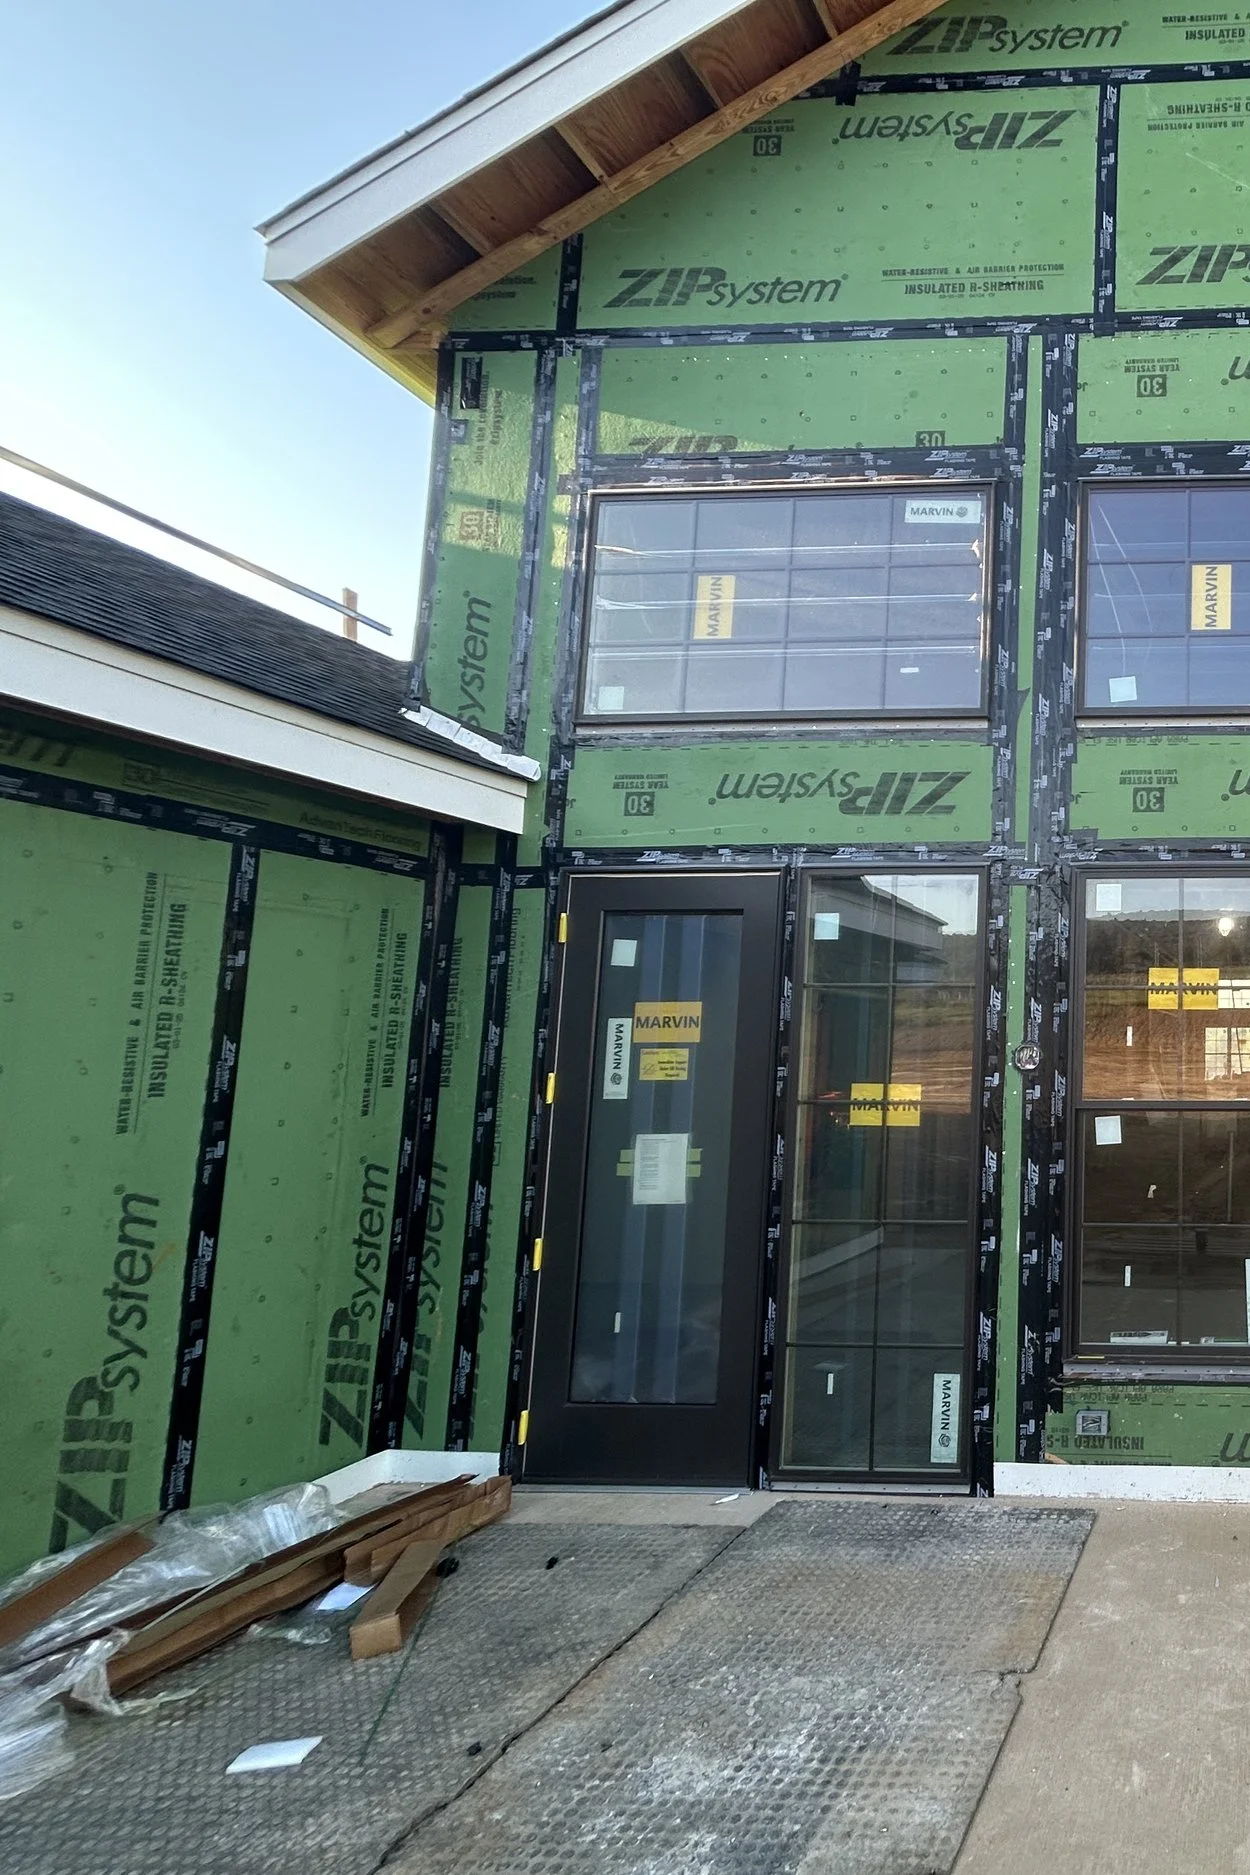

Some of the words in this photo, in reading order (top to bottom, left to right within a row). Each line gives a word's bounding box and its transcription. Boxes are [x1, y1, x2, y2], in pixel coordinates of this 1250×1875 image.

[1185, 28, 1246, 41] INSULATED
[1167, 101, 1242, 115] R-SHEATHING
[755, 136, 780, 156] 30
[882, 266, 949, 277] WATER-RESISTIVE
[966, 265, 981, 274] AIR
[1019, 262, 1065, 272] PROTECTION
[905, 282, 966, 295] INSULATED
[1124, 365, 1154, 374] SYSTEM
[1155, 364, 1181, 373] YEAR
[1139, 375, 1166, 397] 30
[917, 432, 944, 447] 30
[909, 506, 954, 518] MARVIN
[705, 576, 722, 637] MARVIN
[1205, 565, 1218, 629] MARVIN
[612, 781, 642, 790] SYSTEM
[643, 780, 669, 789] YEAR
[1119, 776, 1151, 786] SYSTEM
[1153, 775, 1179, 785] YEAR
[625, 793, 654, 815] 30
[1135, 788, 1163, 811] 30
[141, 871, 158, 936] PROTECTION
[134, 939, 151, 986] BARRIER
[159, 902, 188, 1007] R-SHEATHING
[131, 989, 145, 1010] AIR
[382, 1019, 399, 1089] INSULATED
[391, 932, 408, 1015] R-SHEATHING
[635, 1015, 700, 1030] MARVIN
[148, 1011, 174, 1098] INSULATED
[613, 1022, 624, 1071] MARVIN
[115, 1035, 139, 1136] WATER-RESISTIVE
[941, 1379, 953, 1432] MARVIN
